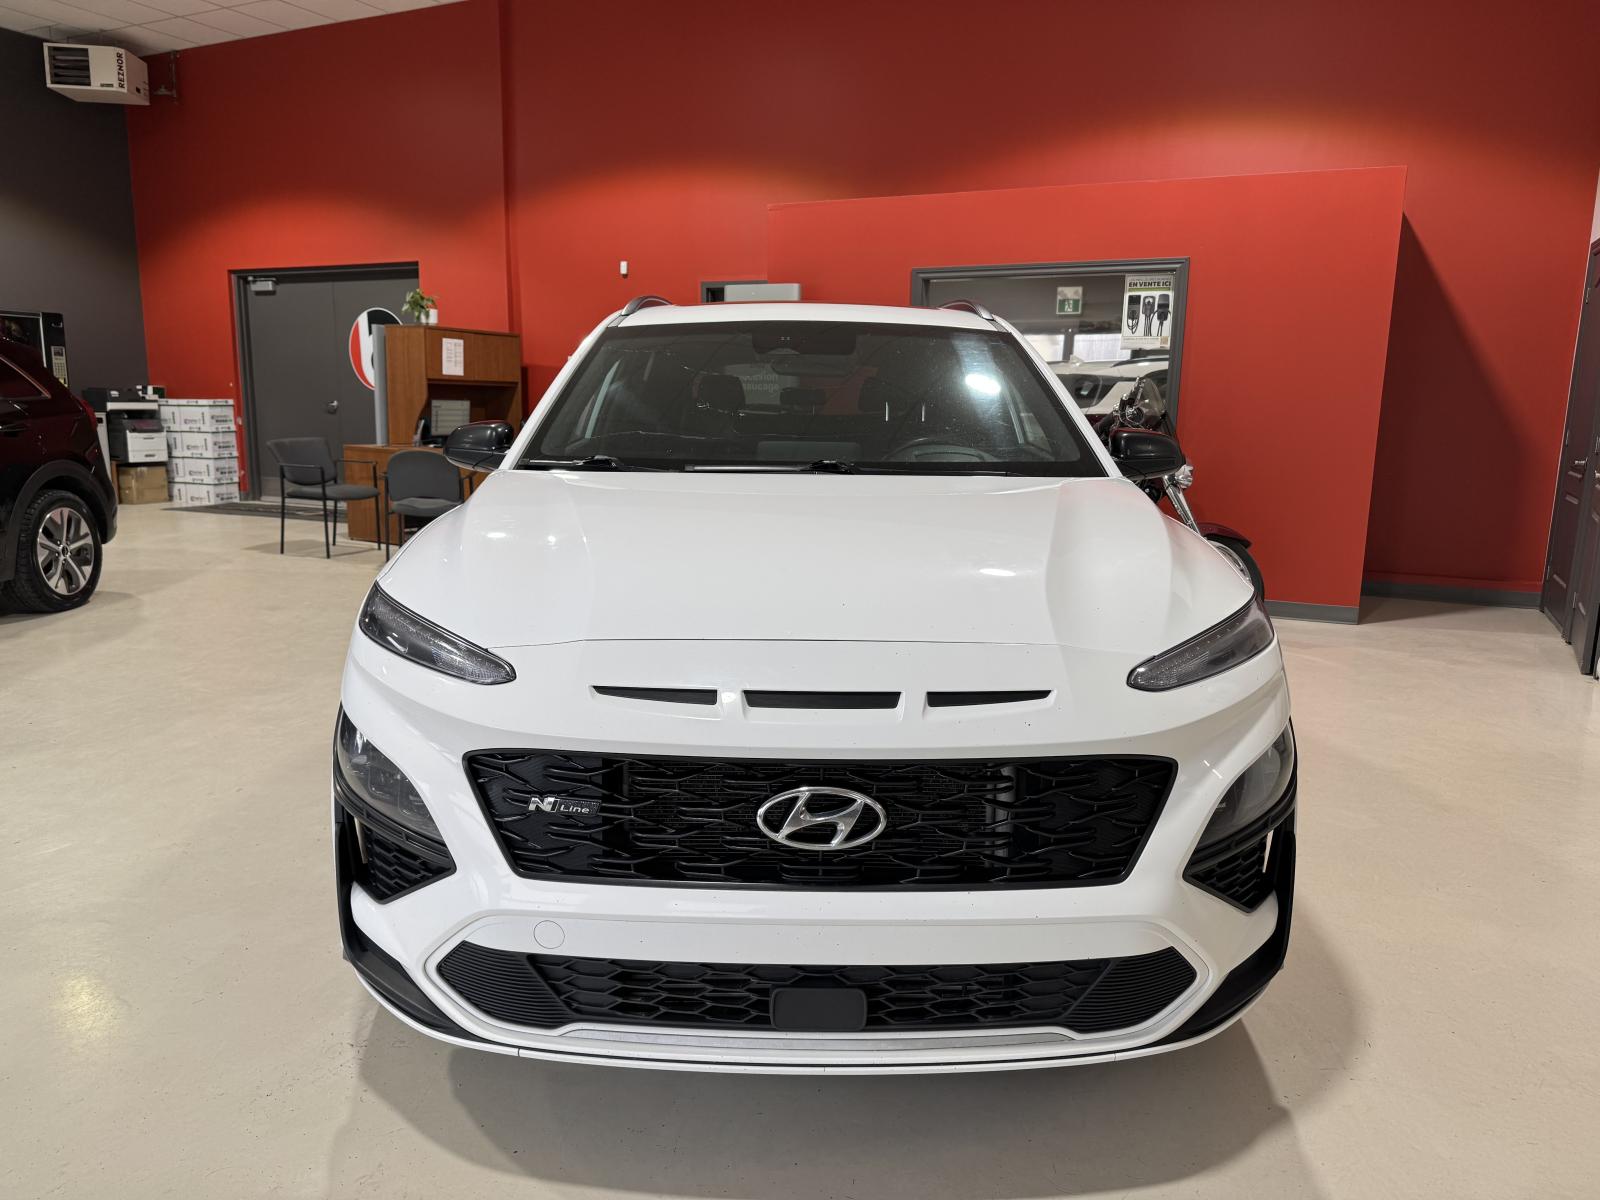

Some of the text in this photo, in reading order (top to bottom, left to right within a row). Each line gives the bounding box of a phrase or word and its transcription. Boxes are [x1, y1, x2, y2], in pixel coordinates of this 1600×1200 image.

[116, 52, 126, 89] REZNOR
[528, 797, 590, 814] N Line
